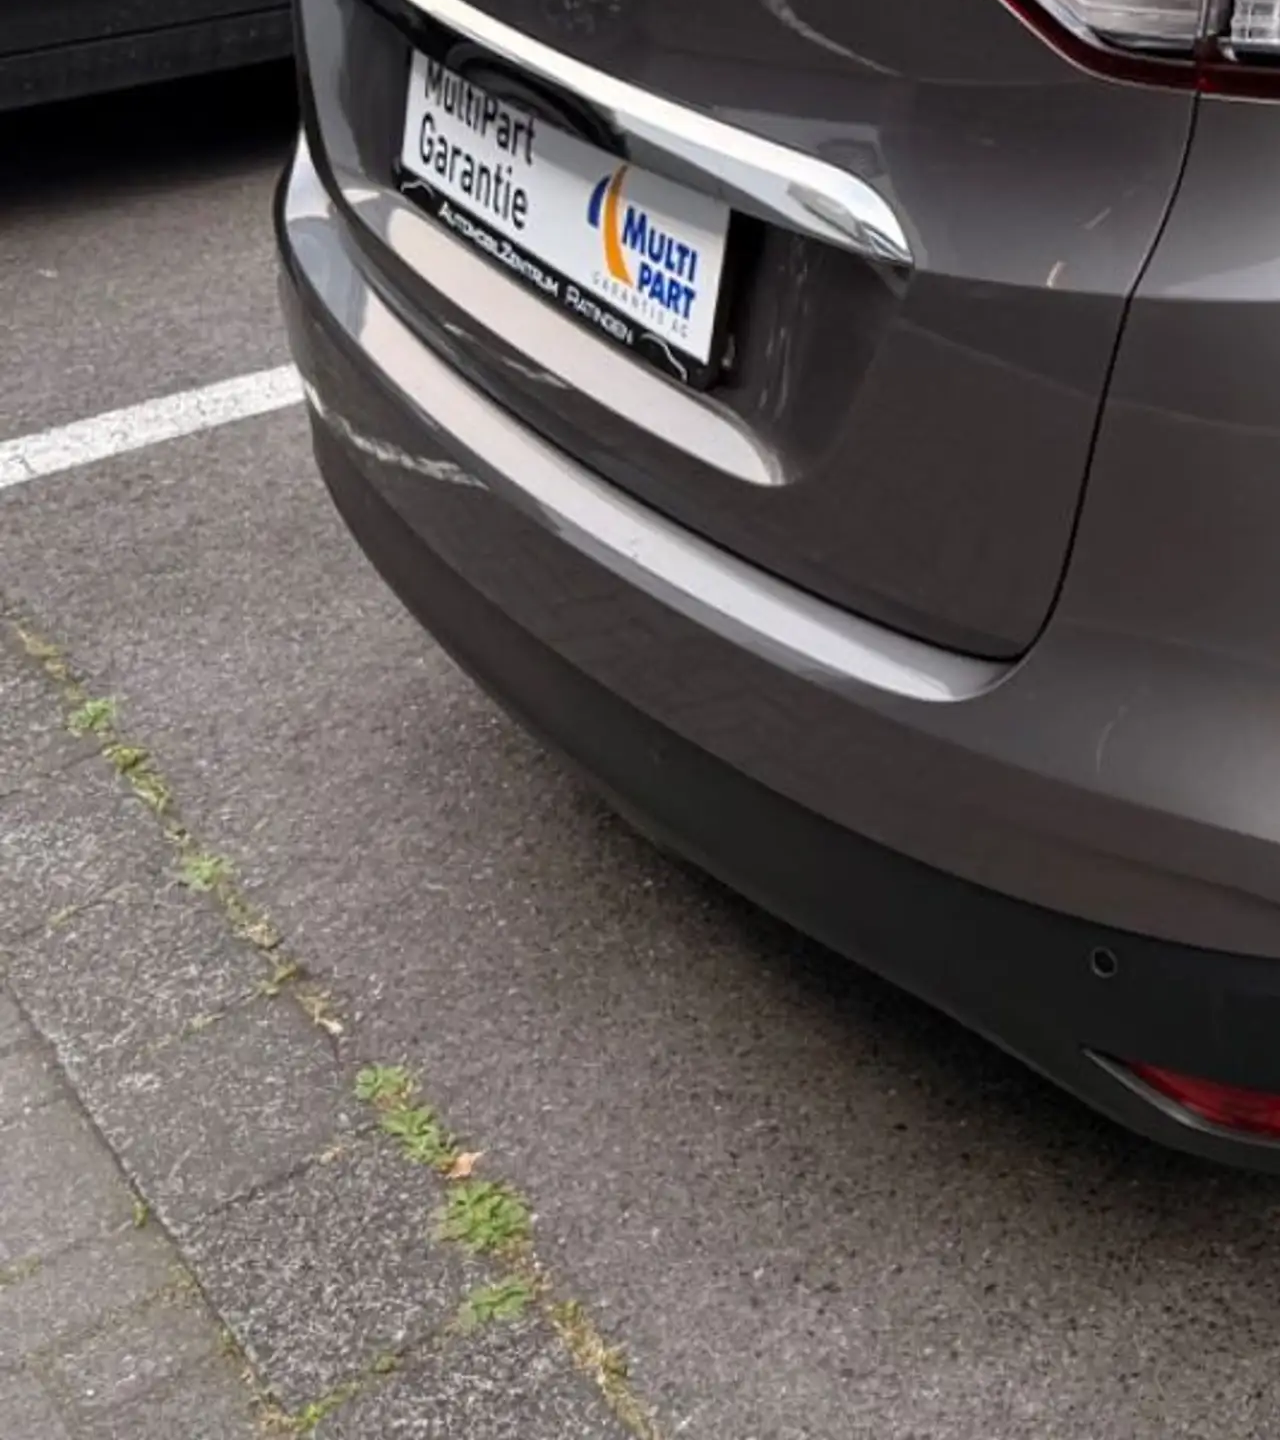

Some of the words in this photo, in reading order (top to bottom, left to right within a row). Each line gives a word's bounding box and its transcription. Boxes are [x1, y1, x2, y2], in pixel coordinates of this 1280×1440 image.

[424, 58, 536, 168] MultiPart
[419, 111, 529, 231] Garantie
[622, 205, 698, 283] MULTI
[638, 261, 696, 320] PART
